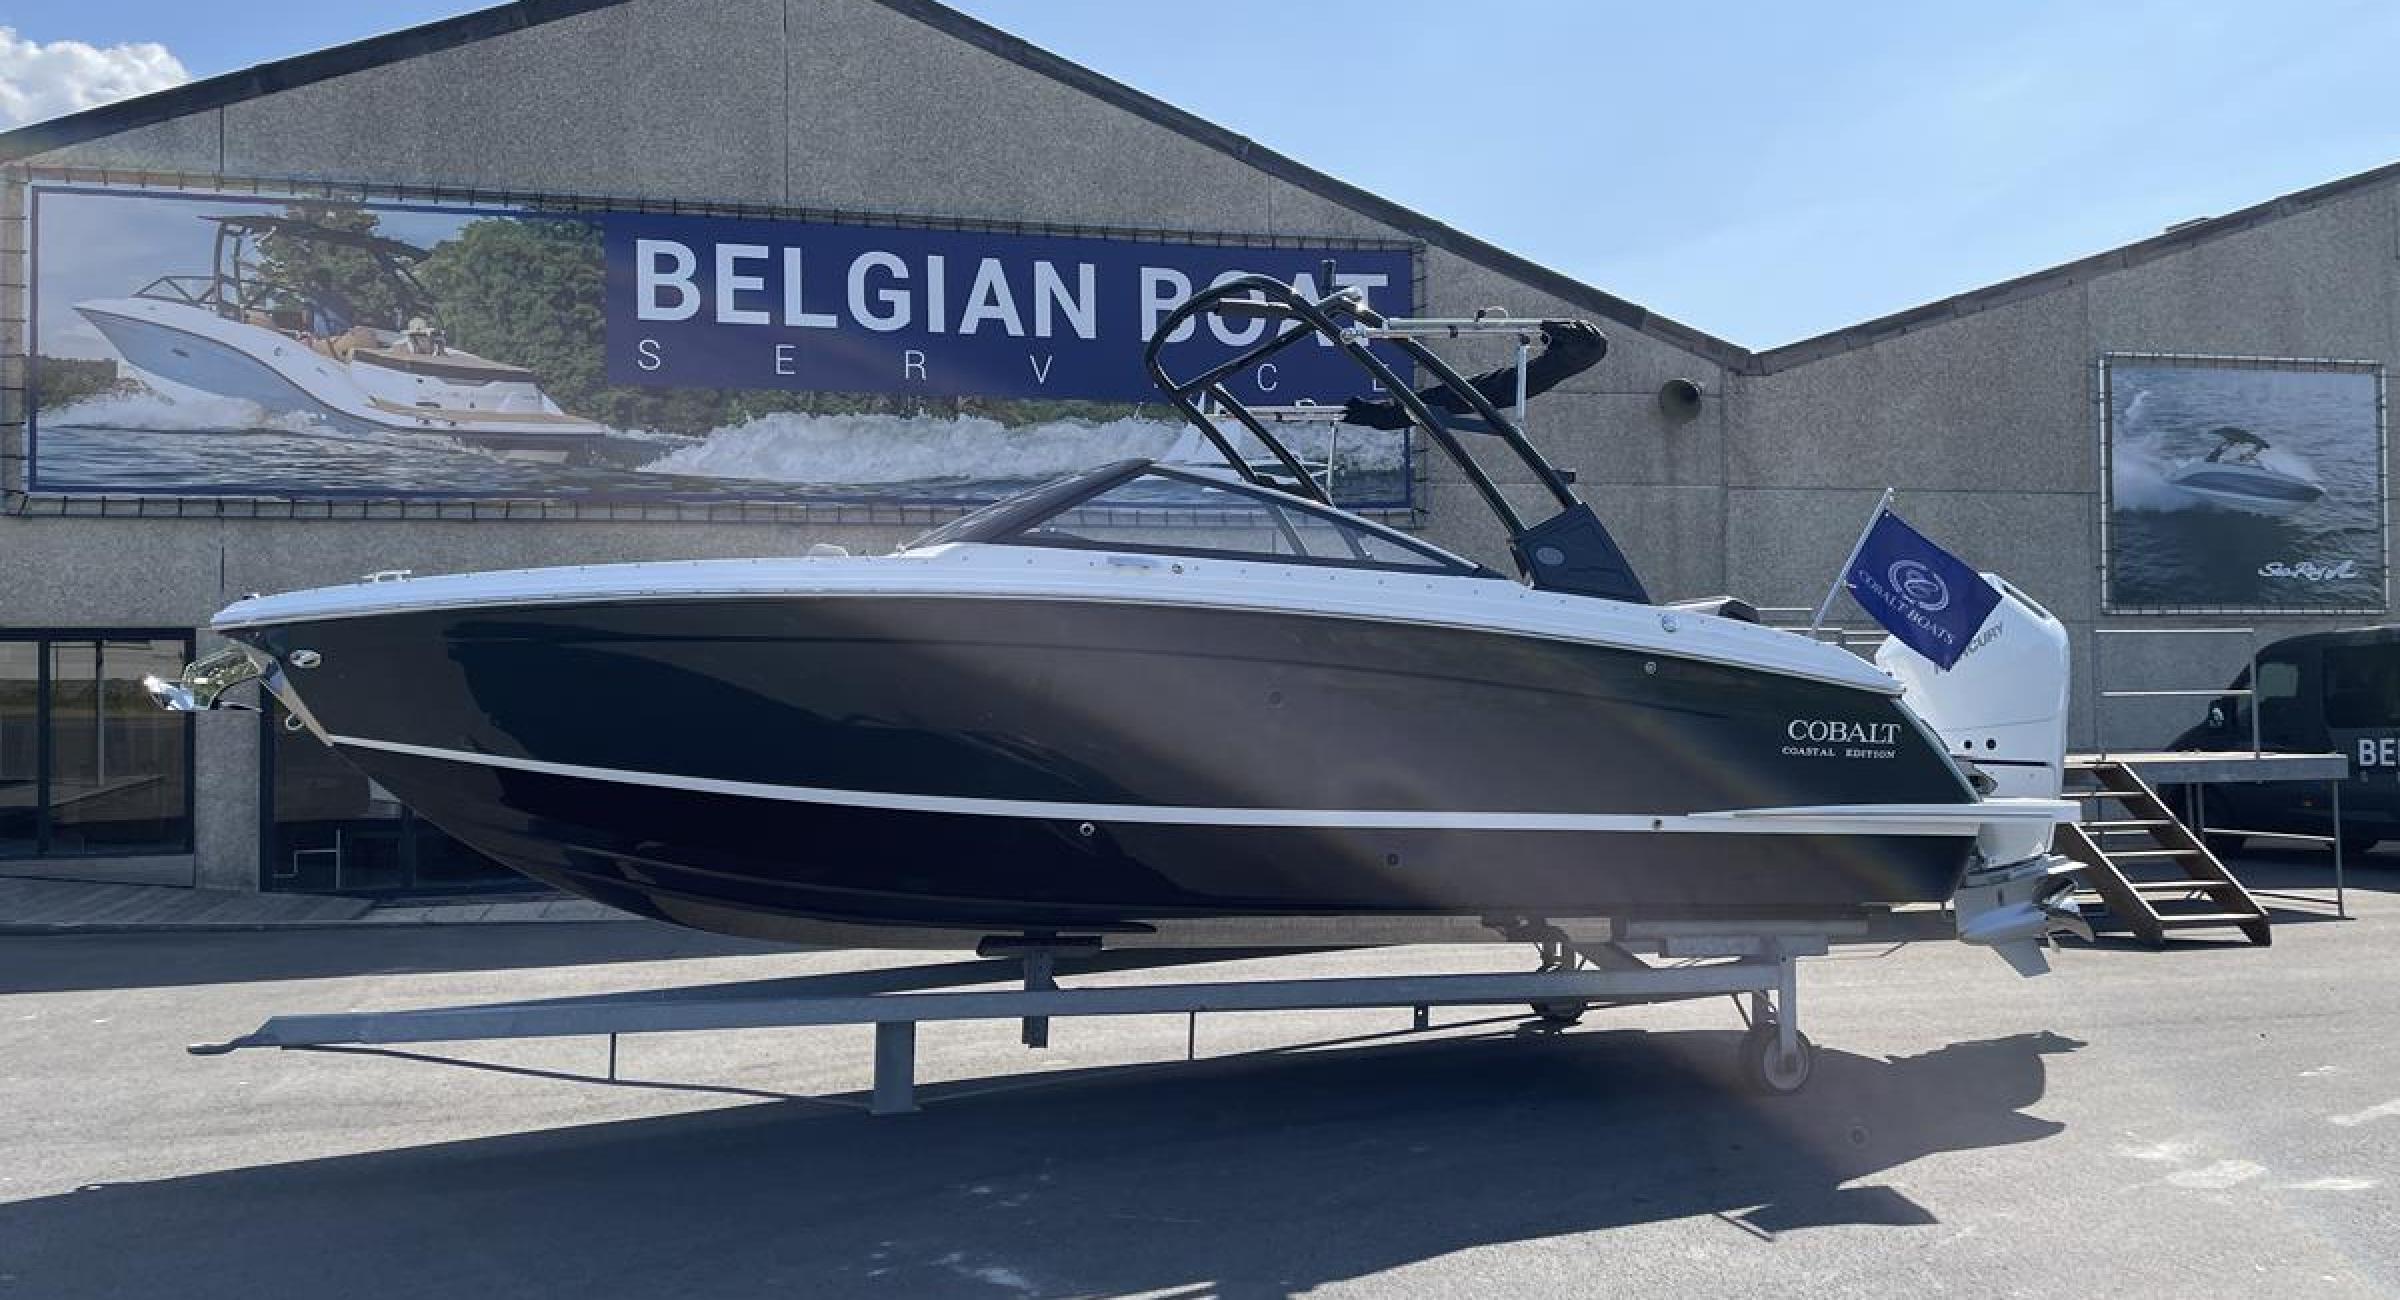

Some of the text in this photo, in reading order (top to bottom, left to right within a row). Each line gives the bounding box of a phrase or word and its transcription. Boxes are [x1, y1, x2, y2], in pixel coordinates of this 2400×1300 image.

[637, 239, 1097, 339] BELGIAN
[637, 339, 1392, 393] SERVC
[1907, 609, 1954, 645] BOATS
[1787, 719, 1901, 744] COBALT
[1781, 746, 1897, 759] COASTAL EDITION
[2359, 738, 2400, 766] BE
